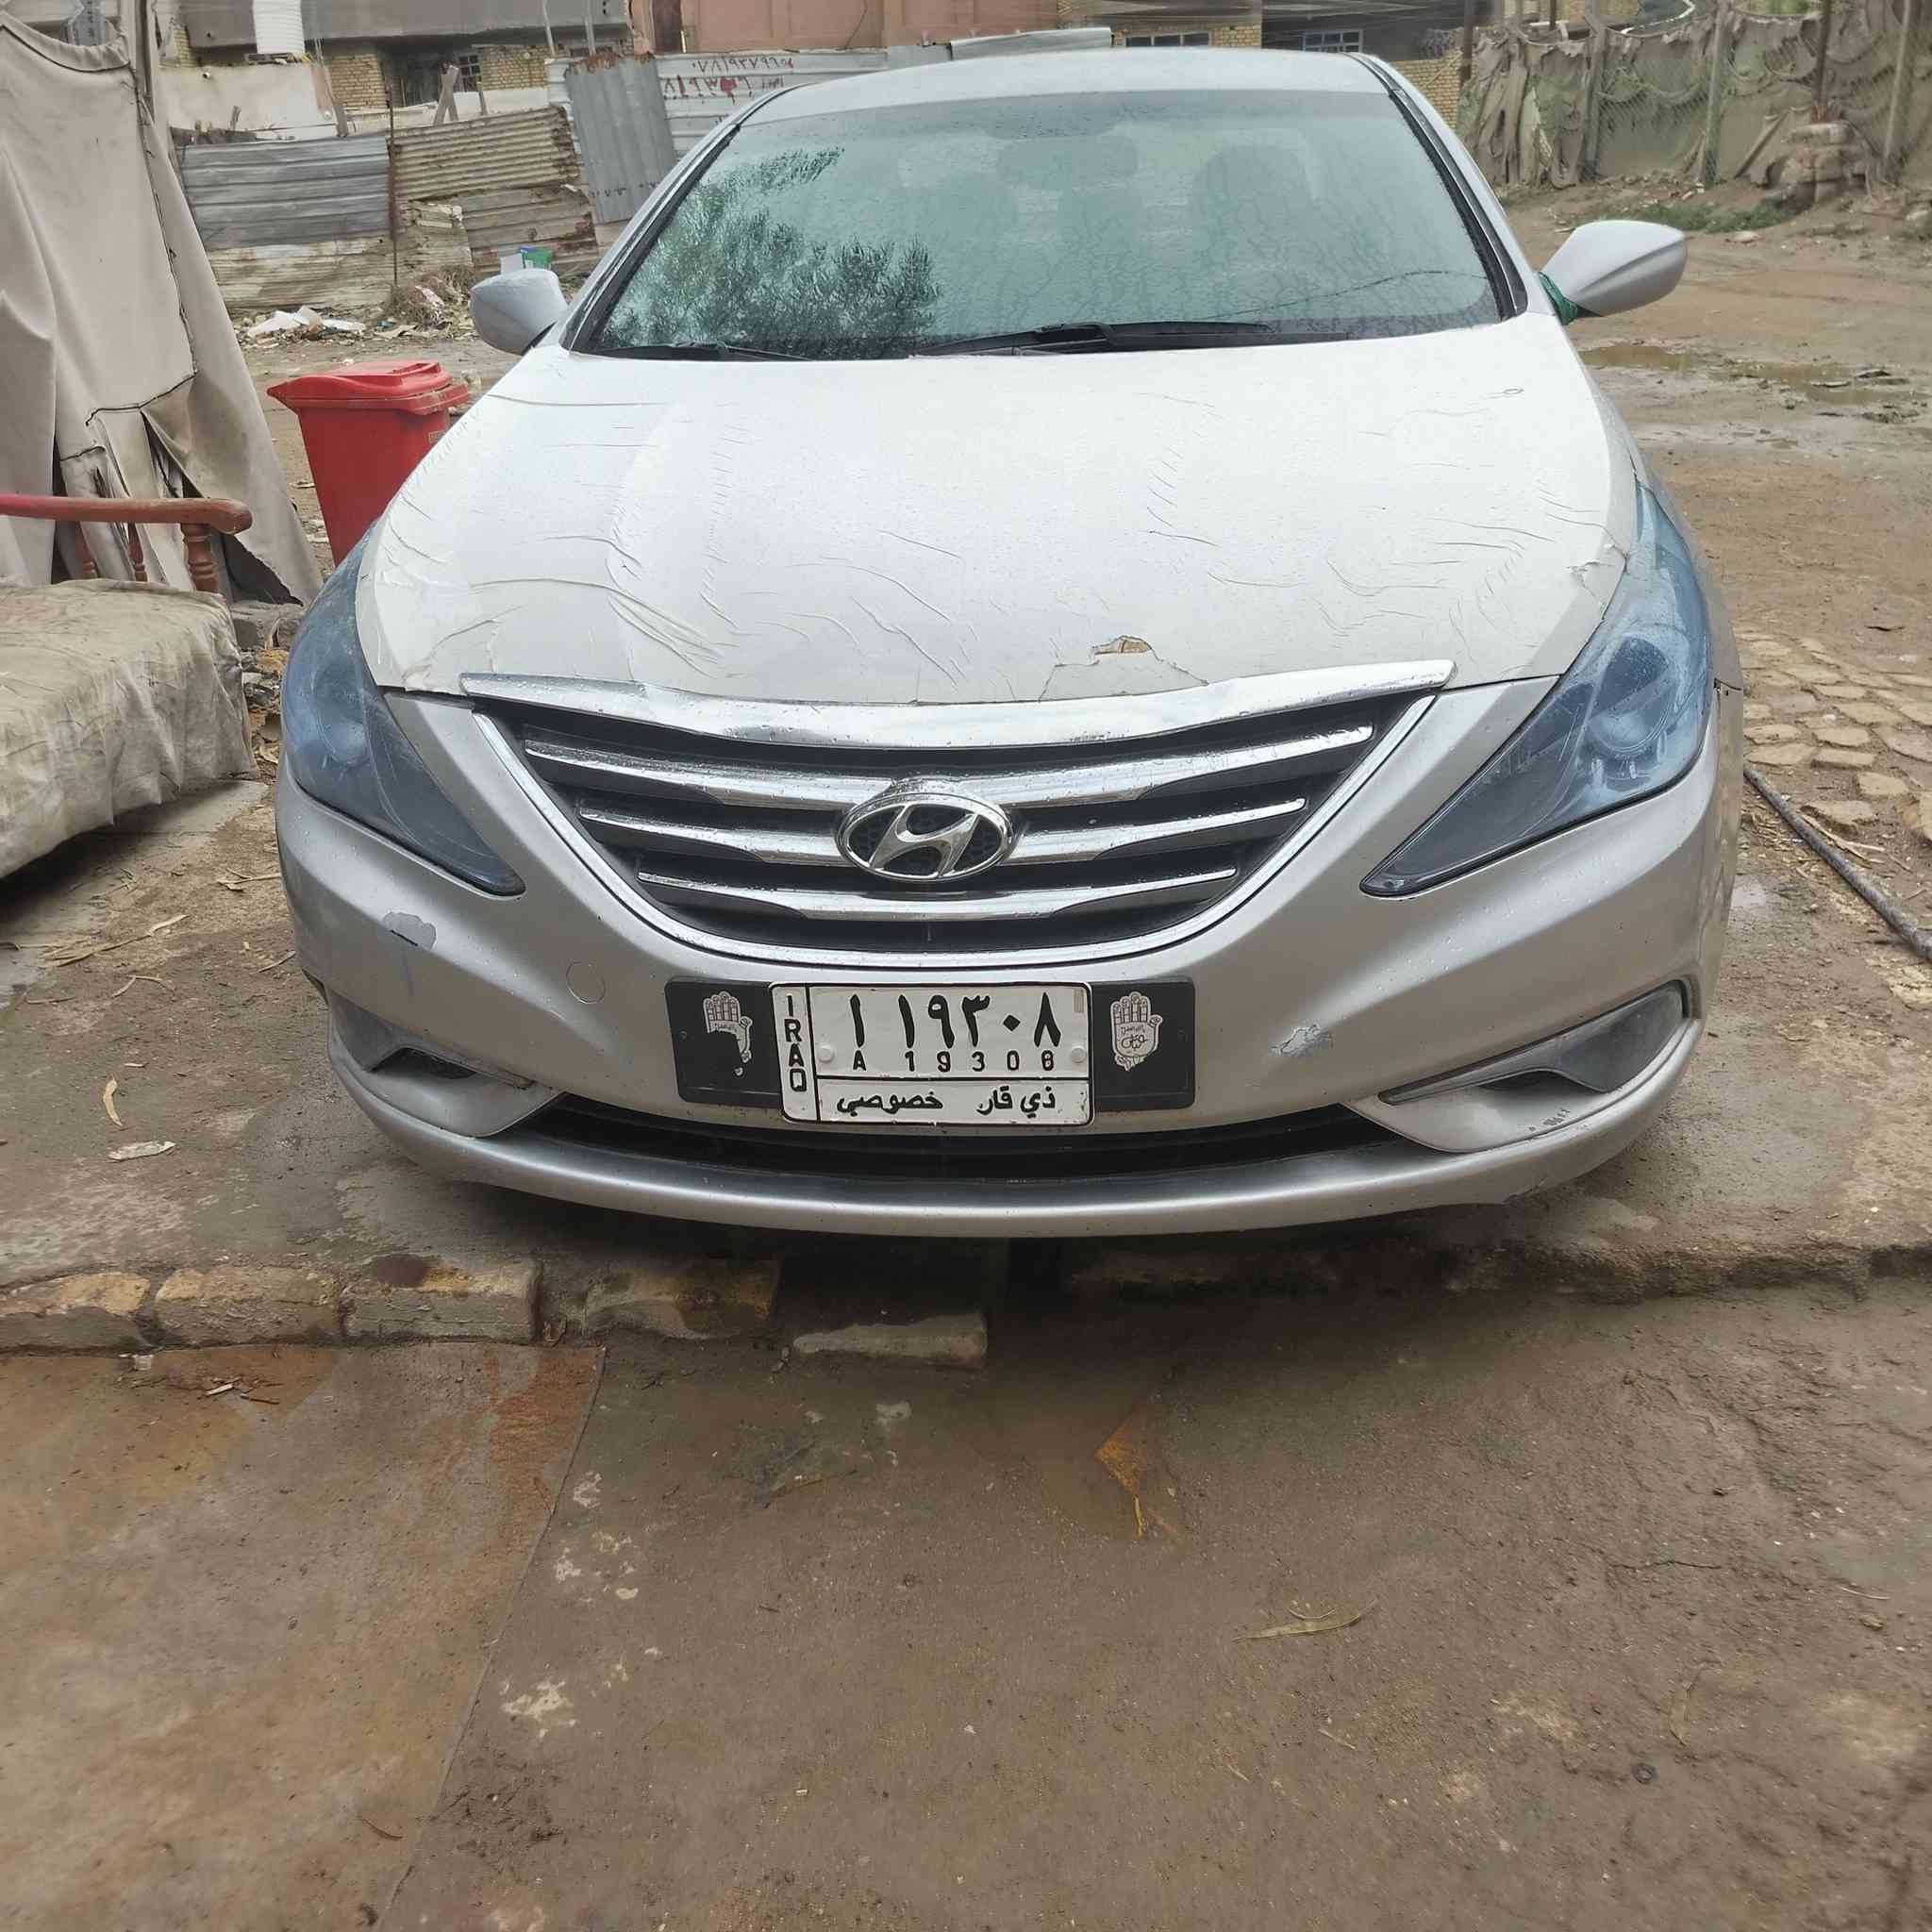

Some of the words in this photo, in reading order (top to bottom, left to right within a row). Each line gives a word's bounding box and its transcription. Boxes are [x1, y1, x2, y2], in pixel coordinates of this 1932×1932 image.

[784, 995, 808, 1092] IRAQ
[837, 1091, 944, 1117] خصوصي
[975, 1085, 1014, 1116] قار
[1020, 1086, 1056, 1119] ذي
